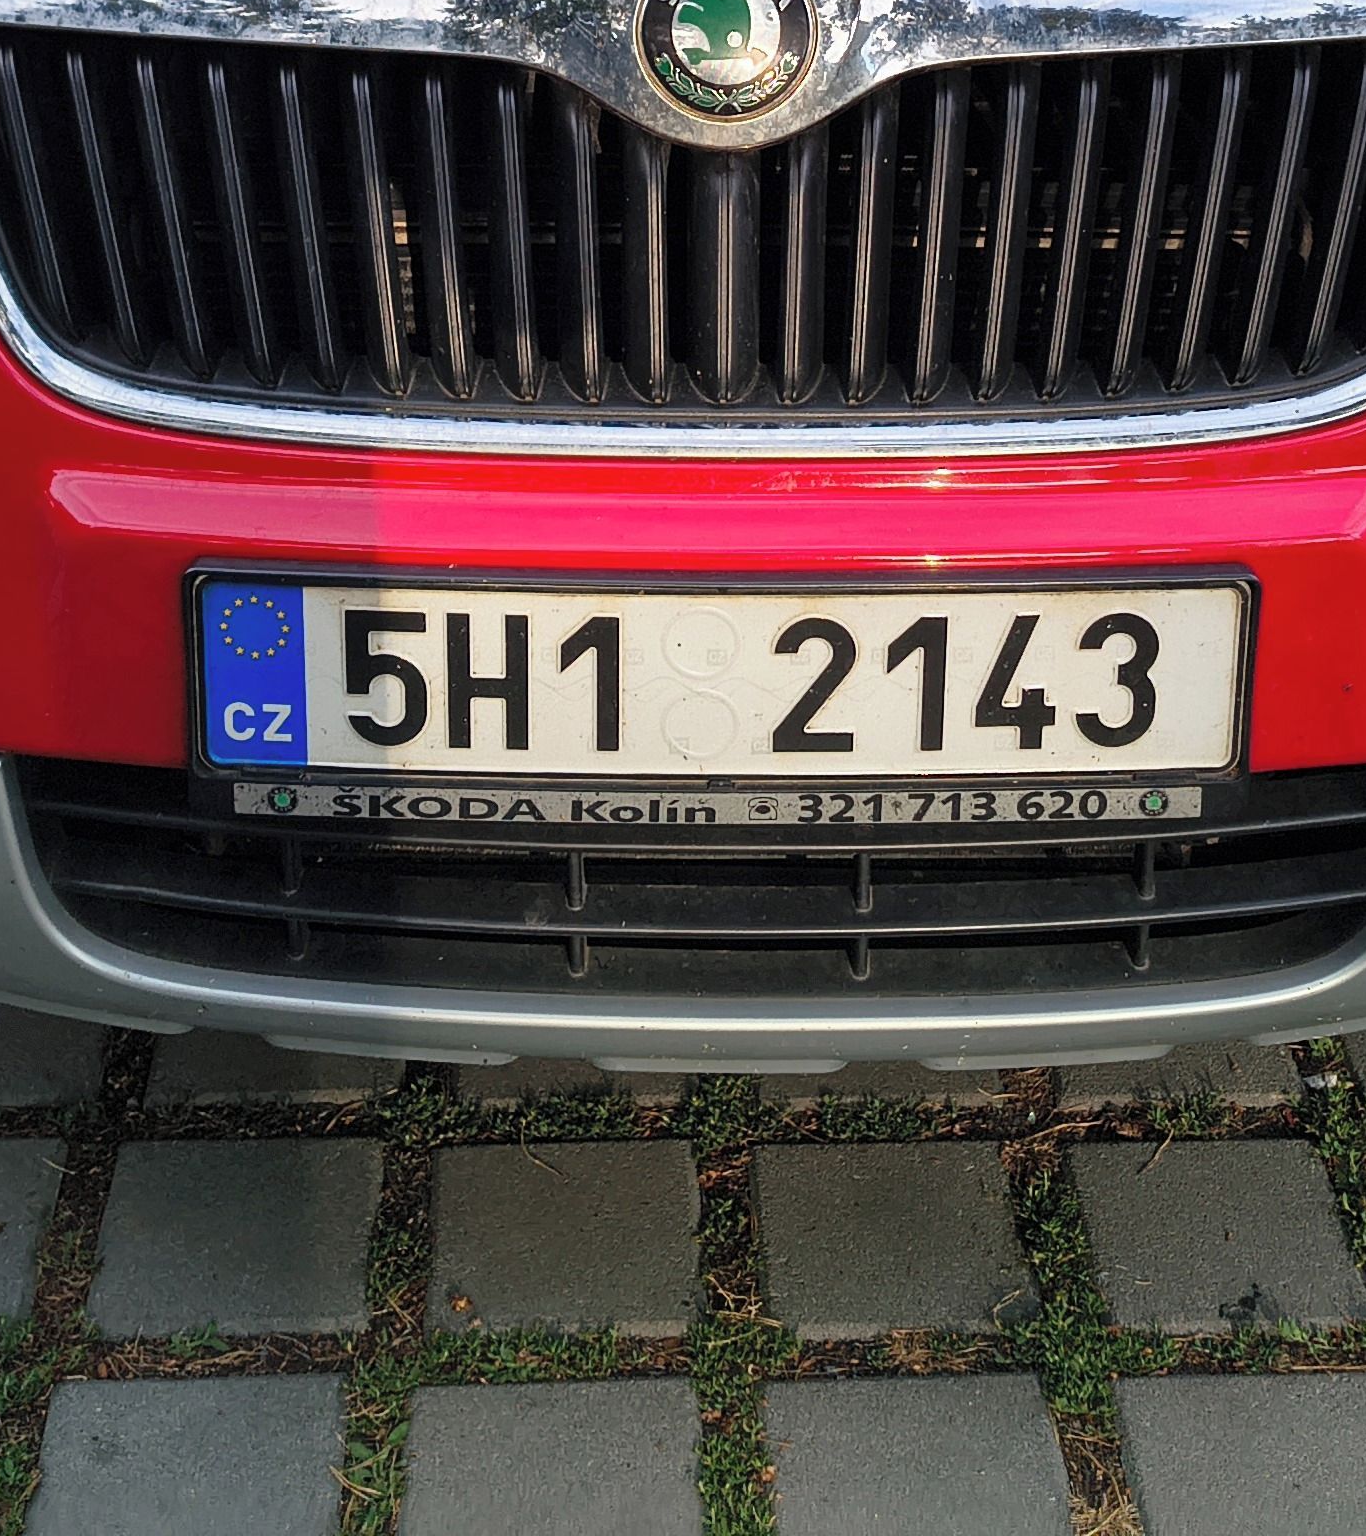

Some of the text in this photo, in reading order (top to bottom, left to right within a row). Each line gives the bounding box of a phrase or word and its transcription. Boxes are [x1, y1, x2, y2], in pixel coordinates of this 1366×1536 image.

[344, 609, 1160, 753] 5H1 2143
[223, 702, 292, 742] CZ
[334, 787, 546, 821] ŠKODA
[570, 799, 716, 823] Kolín
[798, 793, 884, 823] 321
[908, 792, 998, 822] 713
[1015, 790, 1109, 819] 620
